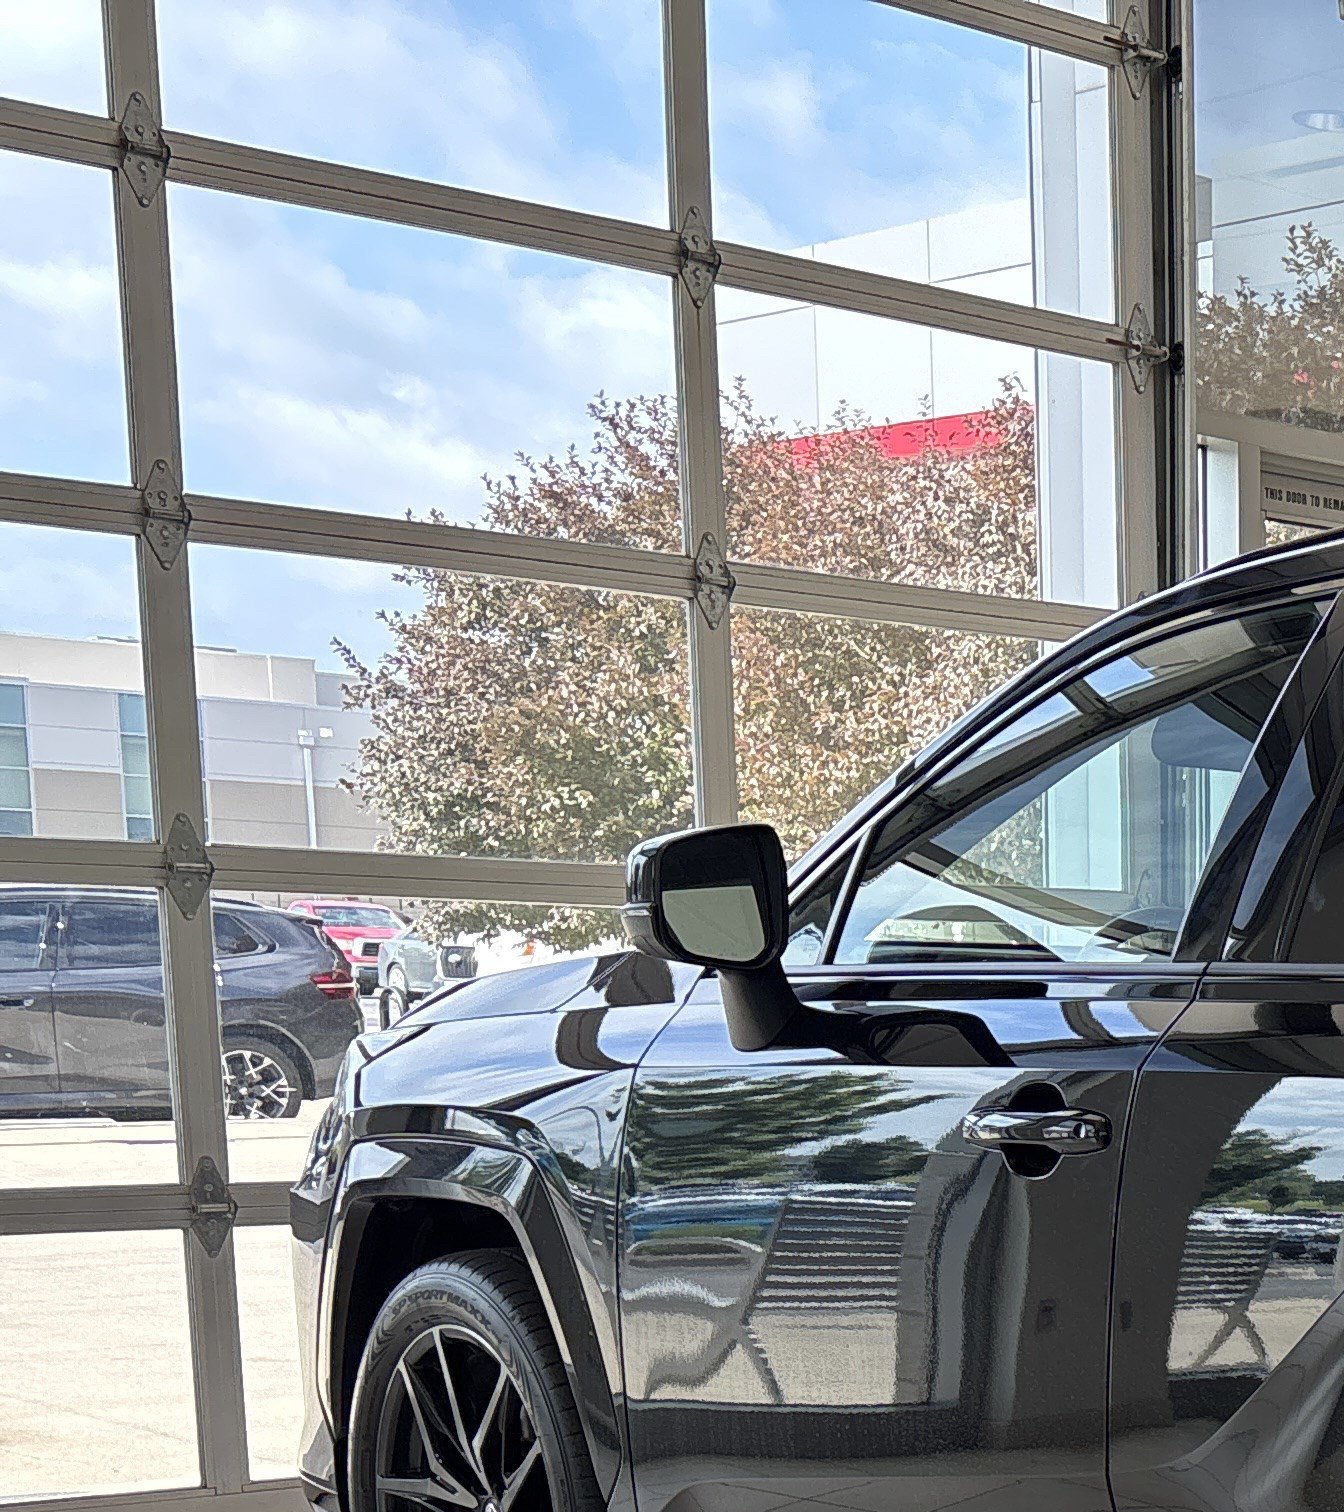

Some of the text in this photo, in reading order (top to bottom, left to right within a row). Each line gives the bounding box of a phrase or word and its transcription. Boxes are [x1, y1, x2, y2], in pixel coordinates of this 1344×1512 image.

[1264, 487, 1283, 501] THIS
[1286, 491, 1307, 505] DOOR
[1310, 495, 1320, 508] TO
[408, 1289, 448, 1303] SPORT
[447, 1292, 492, 1326] MAXX
